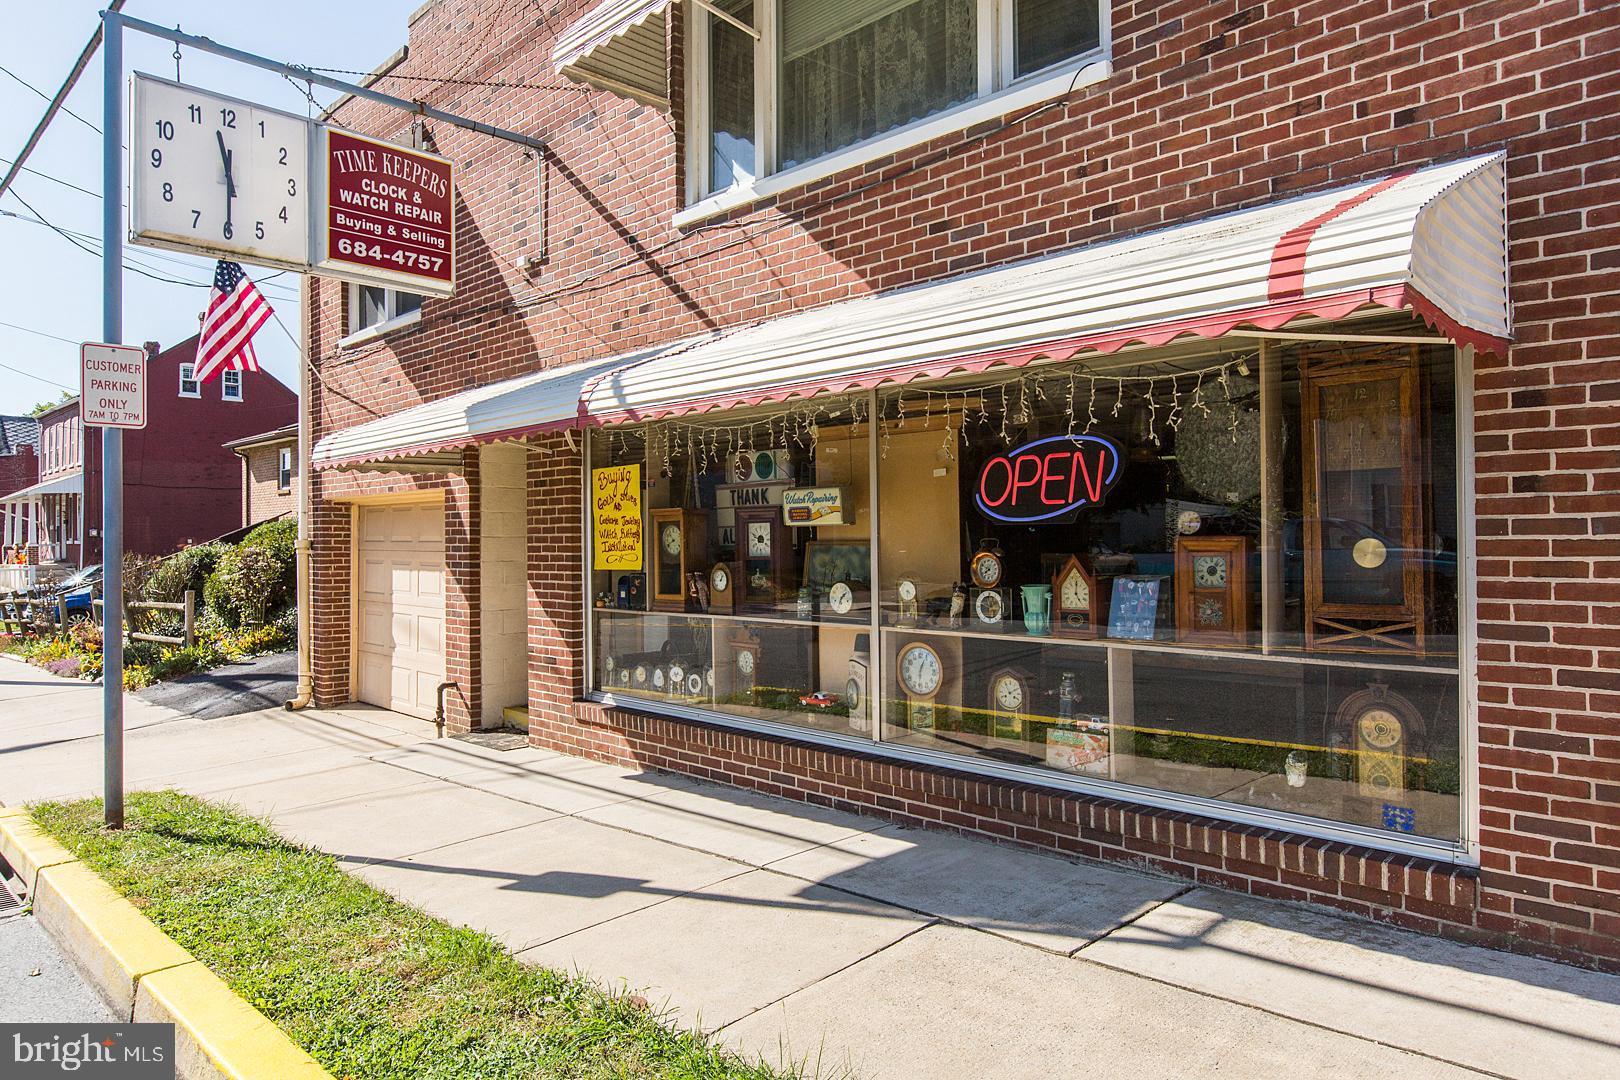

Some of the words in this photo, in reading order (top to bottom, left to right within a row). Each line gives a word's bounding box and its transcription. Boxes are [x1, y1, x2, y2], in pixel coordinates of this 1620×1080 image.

[188, 103, 201, 124] 11
[220, 108, 236, 129] 12
[156, 120, 174, 141] 10
[258, 121, 265, 138] 1
[151, 148, 162, 168] 9
[278, 147, 287, 166] 2
[334, 149, 377, 173] TIME
[382, 152, 448, 198] KEEPERS
[162, 182, 174, 202] 8
[287, 178, 297, 197] 3
[361, 178, 408, 201] CLOCK
[413, 191, 422, 204] &
[278, 206, 288, 224] 4
[339, 188, 389, 212] WATCH
[395, 201, 443, 225] REPAIR
[191, 209, 201, 229] 7
[223, 221, 233, 240] 6
[255, 221, 265, 240] 5
[336, 213, 382, 235] Buying
[387, 224, 397, 236] &
[402, 228, 445, 249] Selling
[338, 238, 444, 272] 684-4757
[85, 359, 142, 375] CUSTOMER
[91, 379, 137, 393] PARKING
[99, 398, 127, 410] ONLY
[88, 410, 105, 419] 7AM
[109, 411, 119, 420] TO
[124, 413, 140, 421] 7PM
[980, 449, 1105, 507] OPEN
[730, 488, 770, 505] THANK
[785, 492, 806, 505] Watch
[806, 490, 838, 506] Repairing
